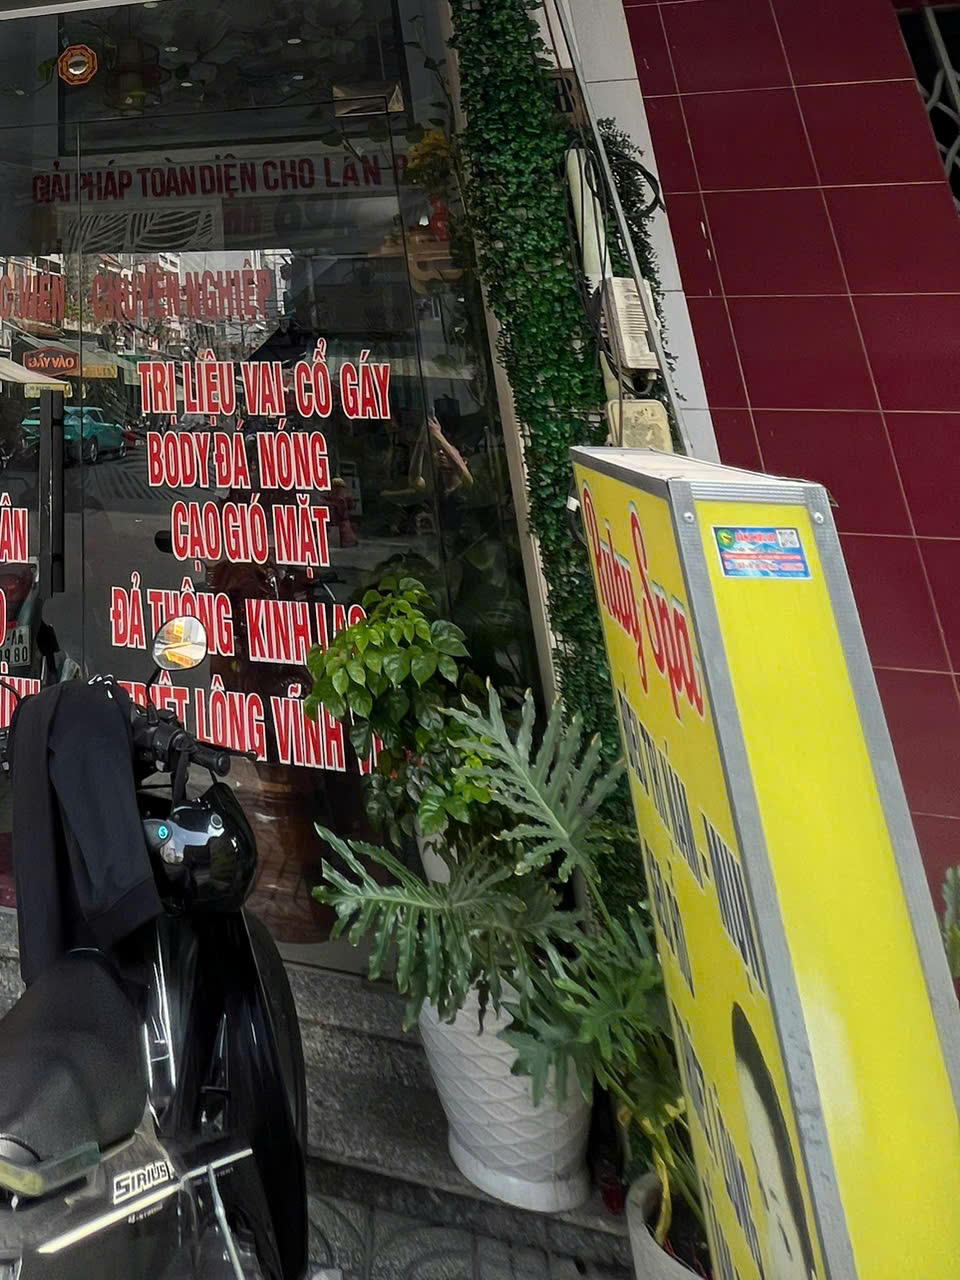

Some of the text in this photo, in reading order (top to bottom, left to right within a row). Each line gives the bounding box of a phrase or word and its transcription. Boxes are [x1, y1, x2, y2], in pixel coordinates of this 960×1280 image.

[75, 159, 132, 201] PHÁP
[137, 156, 197, 197] TOÀN
[199, 153, 257, 198] DIỆN
[262, 157, 316, 191] CHO
[137, 337, 391, 426] TRỊ LIỆU VAI CỔ GÁY
[147, 418, 330, 492] BODY ĐÁ NÓNG
[171, 488, 331, 580] CẠO GIÓ MẶT
[110, 571, 147, 650] ĐẢ
[245, 598, 313, 666] KINH
[630, 508, 705, 724] Spa
[195, 674, 267, 762] LÔNG
[270, 683, 346, 772] VĨNH
[113, 1159, 172, 1206] SIRIUS
